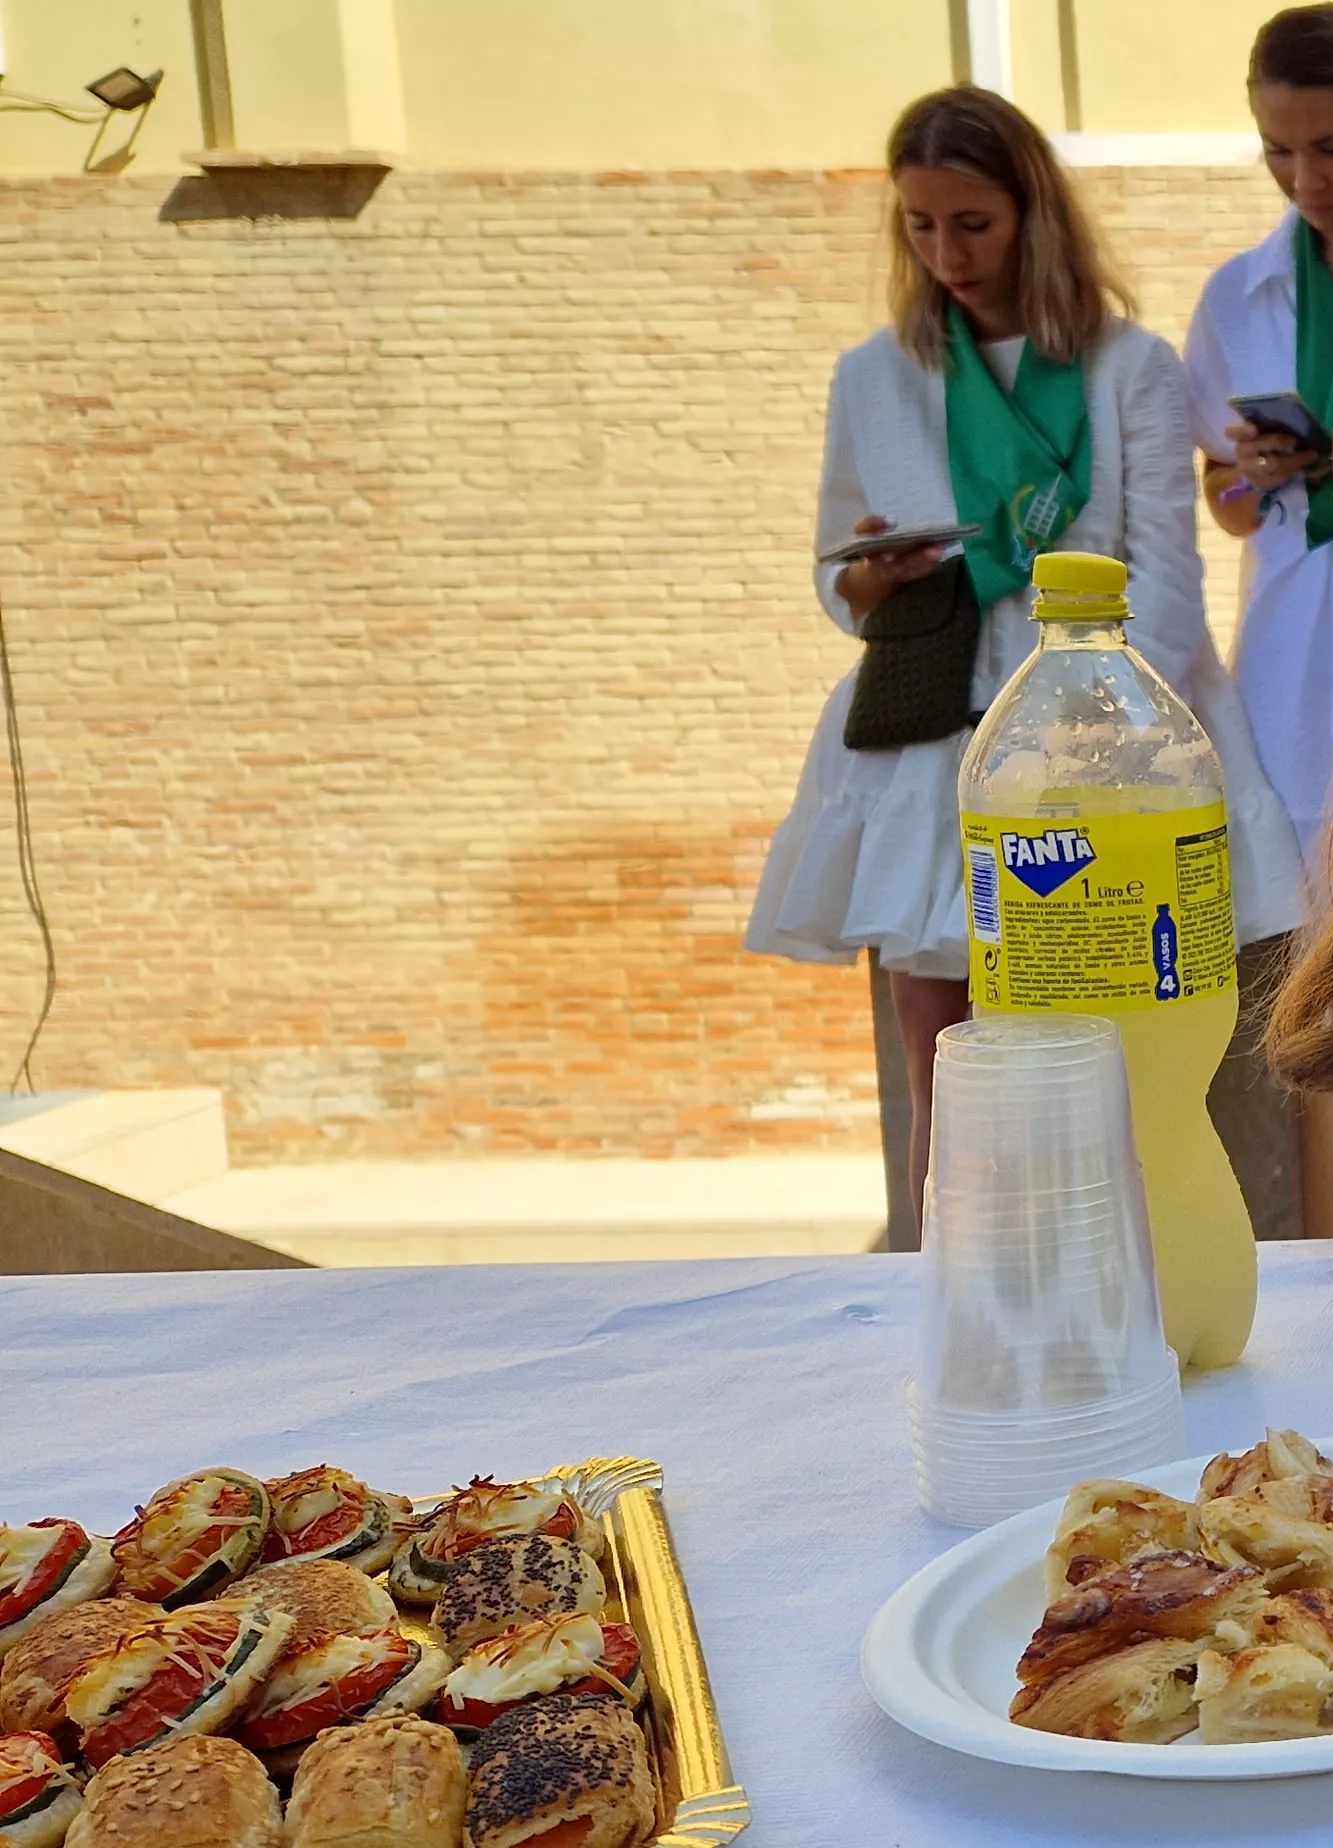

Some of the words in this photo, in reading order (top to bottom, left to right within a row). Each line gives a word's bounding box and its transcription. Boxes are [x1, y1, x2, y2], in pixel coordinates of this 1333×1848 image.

[1001, 831, 1094, 867] FANTA
[1081, 878, 1090, 899] 1
[1097, 887, 1123, 898] Litro
[1160, 932, 1171, 970] VASOS
[1160, 974, 1176, 992] 4
